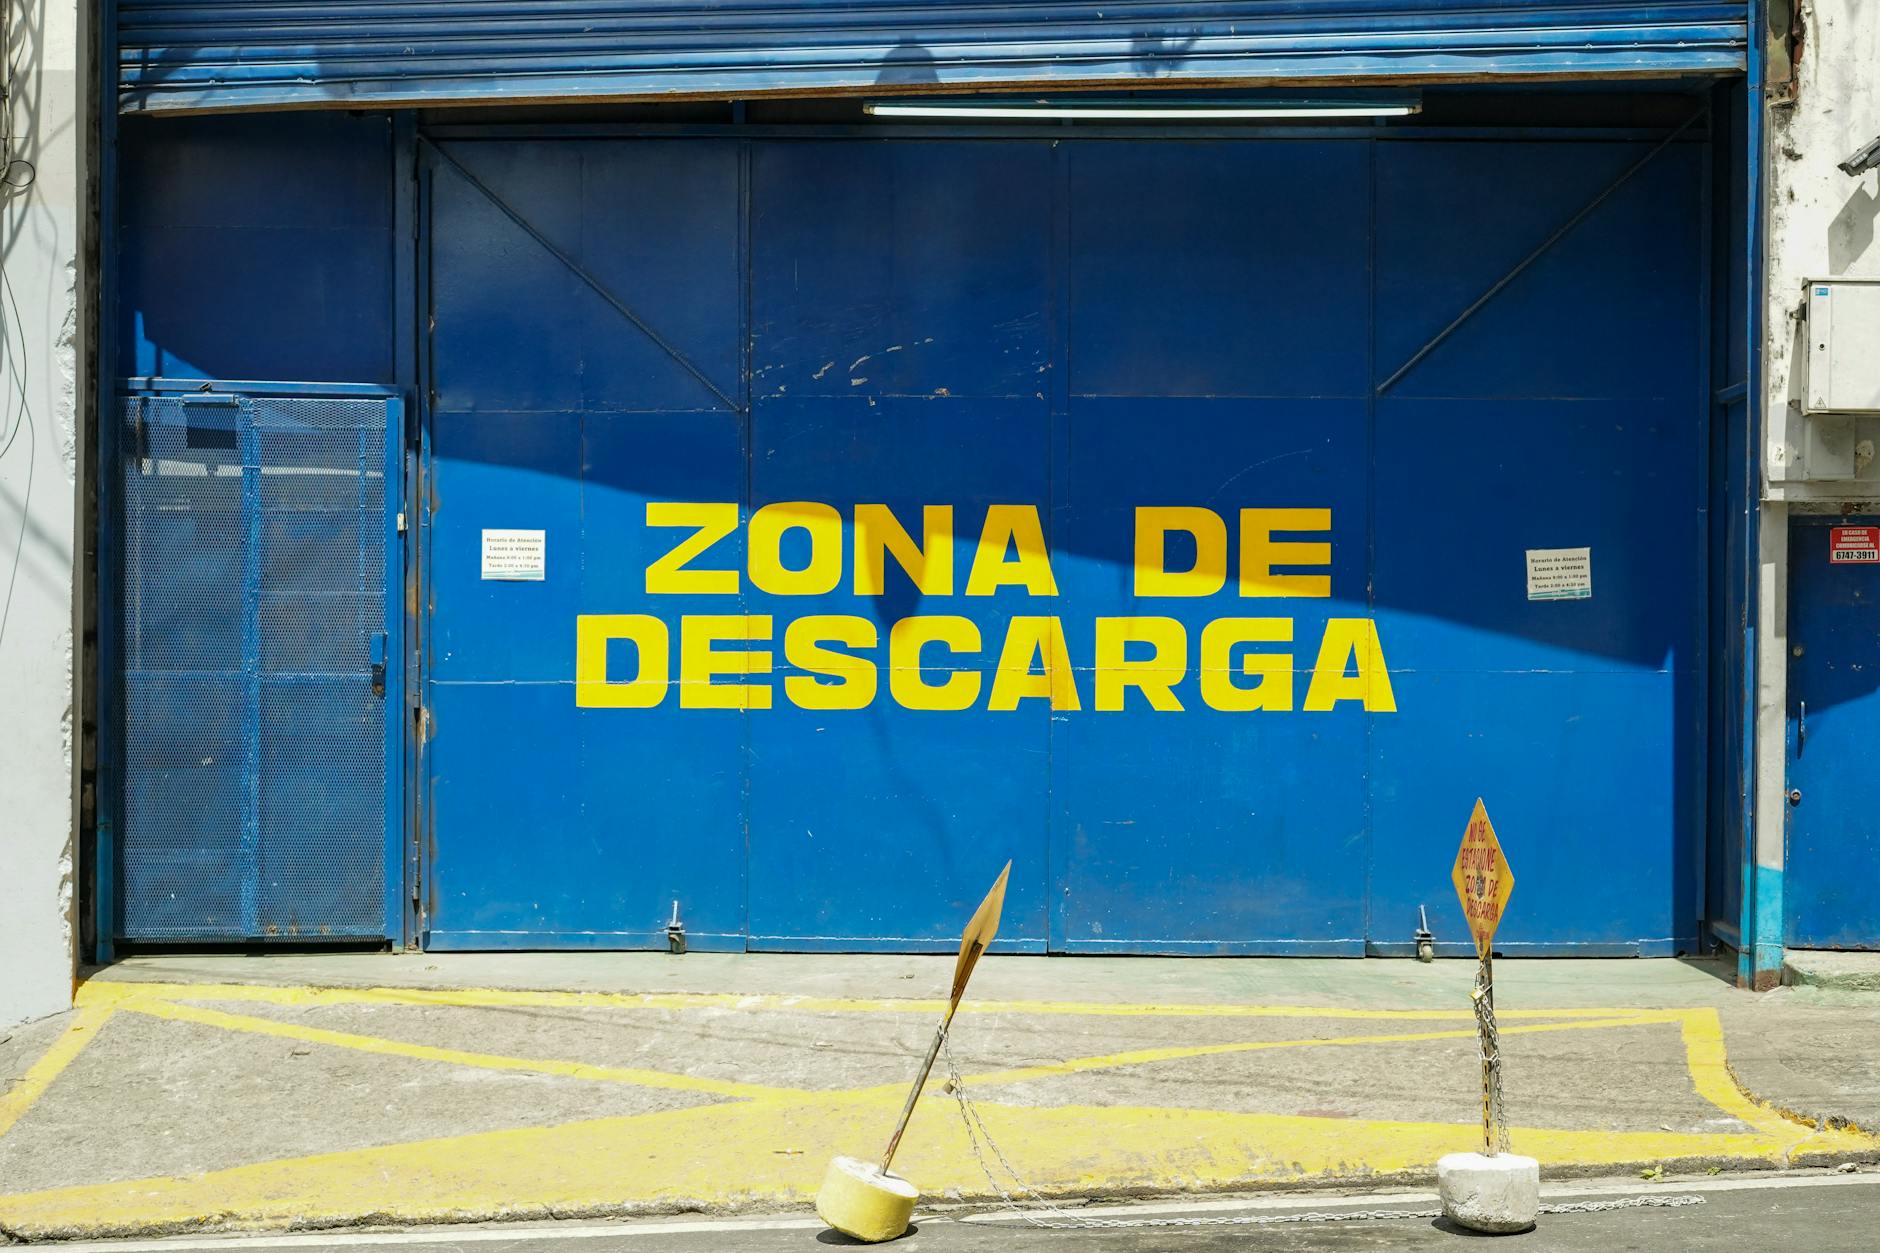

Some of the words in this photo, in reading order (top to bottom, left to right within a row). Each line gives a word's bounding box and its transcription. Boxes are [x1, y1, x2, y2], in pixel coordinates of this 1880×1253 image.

[646, 502, 1059, 596] ZONA
[1134, 506, 1332, 598] DE
[1836, 551, 1875, 560] 6747-3911
[576, 614, 1398, 713] DESCARGA
[1469, 821, 1477, 843] NO
[1478, 820, 1487, 843] SE
[1461, 847, 1497, 873] ESTACIONE
[1465, 873, 1487, 895] ZO
[1488, 879, 1499, 898] DE
[1466, 897, 1500, 922] DESCARGA
